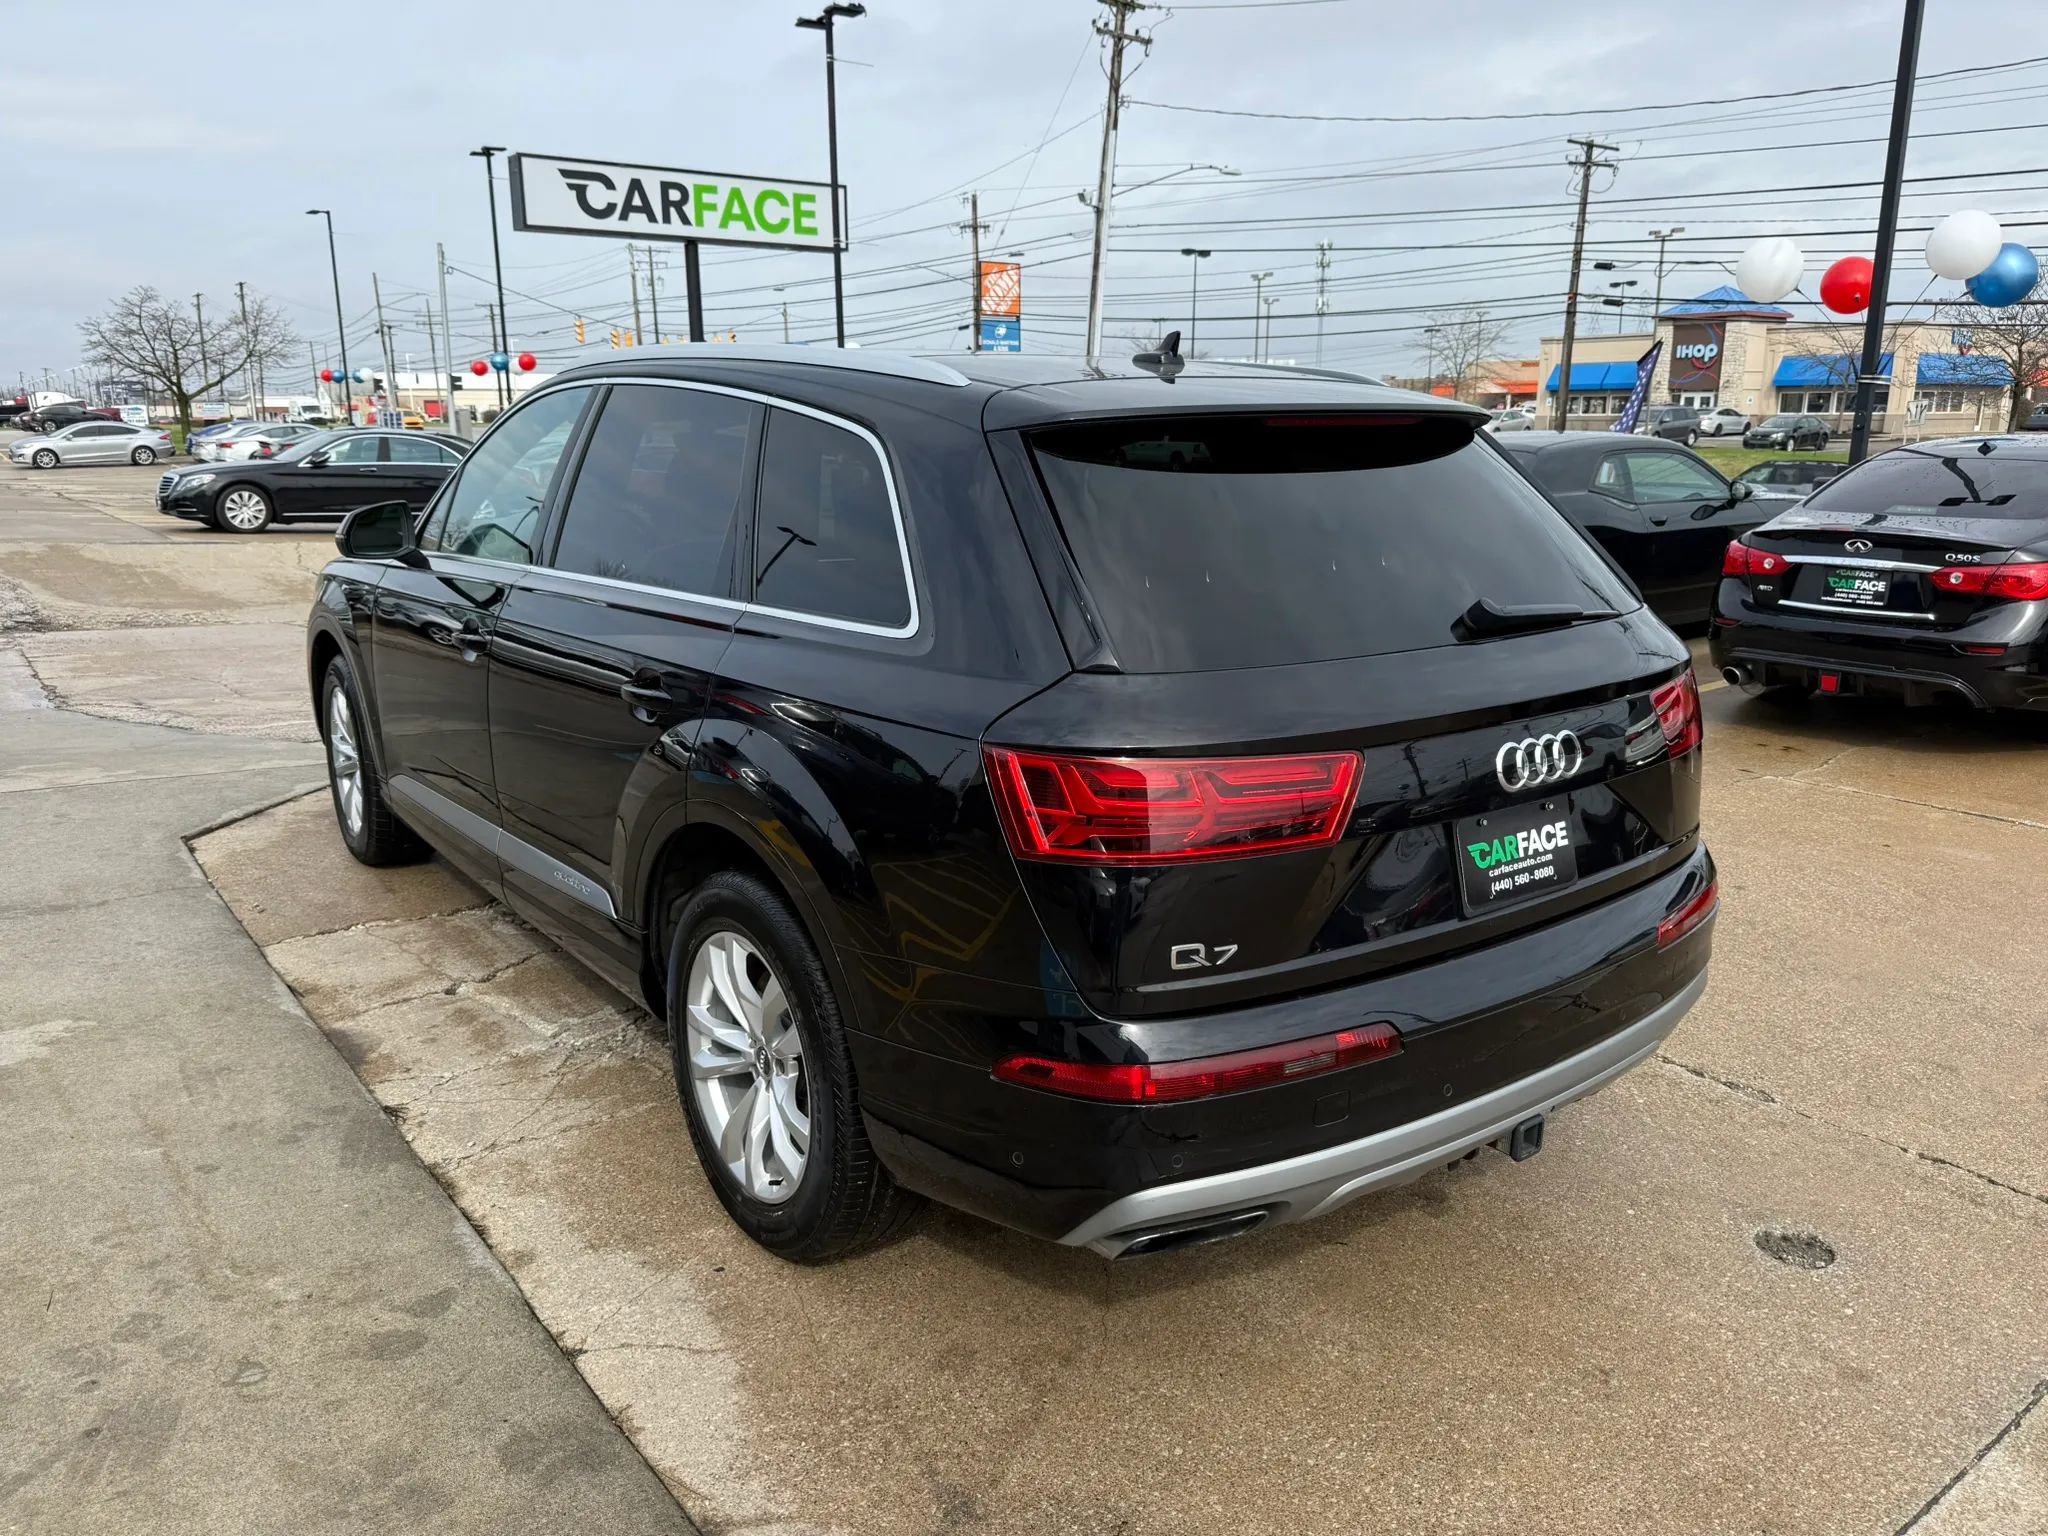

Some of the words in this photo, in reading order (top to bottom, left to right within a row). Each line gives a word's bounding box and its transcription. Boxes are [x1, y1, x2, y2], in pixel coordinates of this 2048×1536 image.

[556, 168, 819, 236] CARFACE
[1827, 576, 1886, 592] CARFACE
[1466, 820, 1569, 870] CARFACE
[1489, 853, 1553, 877] carfaceauto.com
[1491, 877, 1513, 896] (440)
[1170, 943, 1239, 970] Q7
